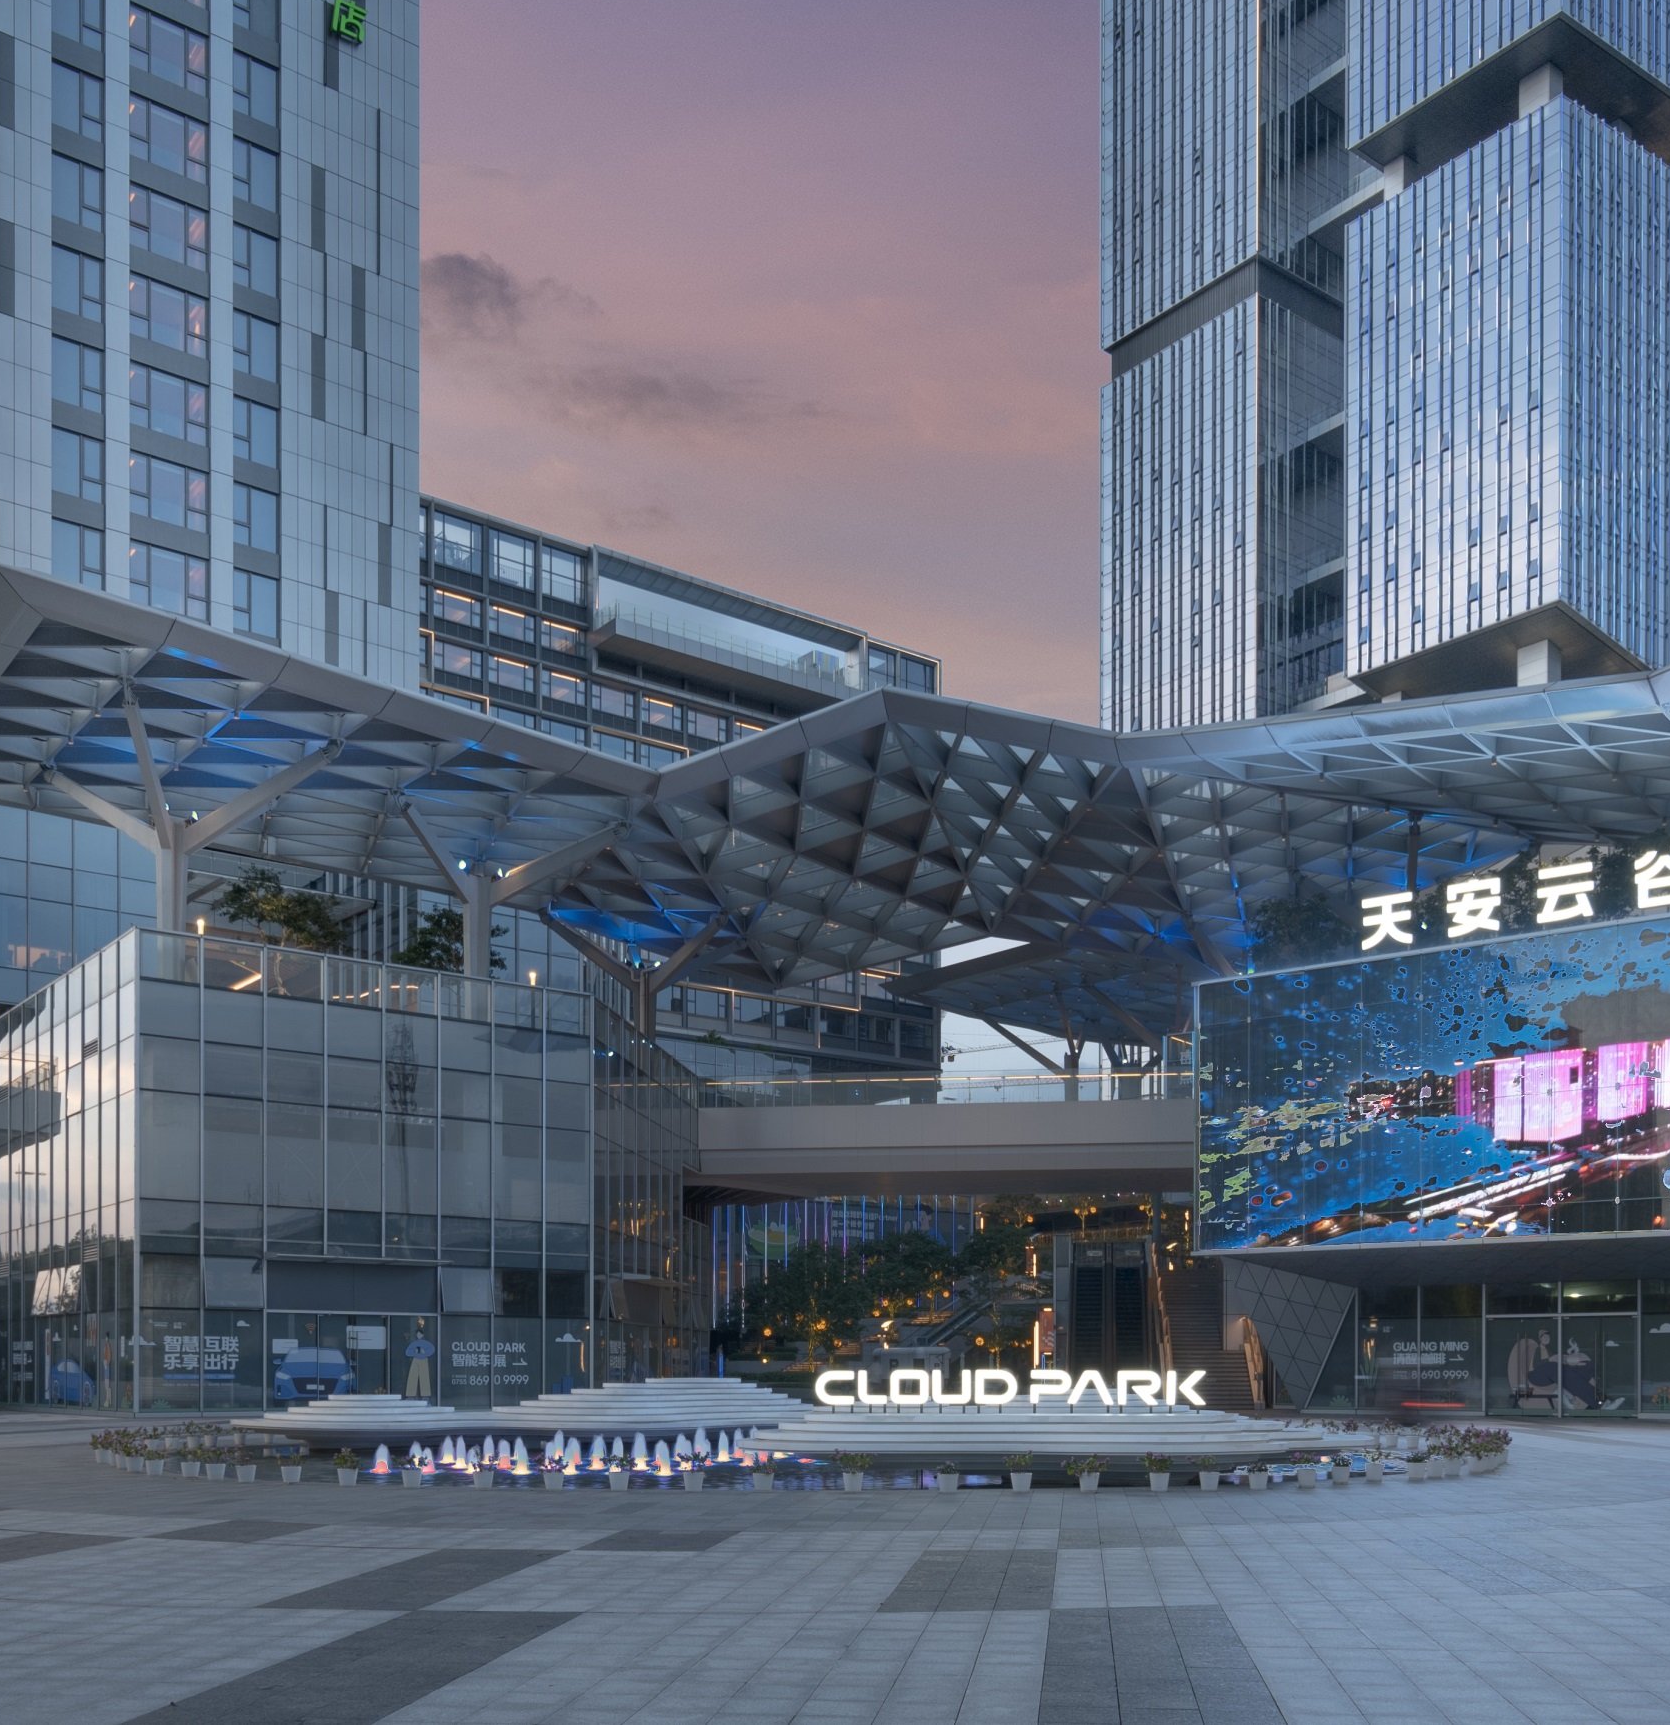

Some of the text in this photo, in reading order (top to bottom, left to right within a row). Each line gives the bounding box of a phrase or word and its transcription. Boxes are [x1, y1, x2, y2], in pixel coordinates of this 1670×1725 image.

[163, 1335, 240, 1353] 智慧互联
[451, 1341, 527, 1353] CLOUD PARK
[1392, 1341, 1470, 1352] GUANG MING
[163, 1353, 240, 1371] 乐享出行
[451, 1353, 507, 1367] 智能车展
[503, 1374, 529, 1385] 9999
[1442, 1370, 1470, 1380] 9999
[815, 1369, 1208, 1406] CLOUD PARK
